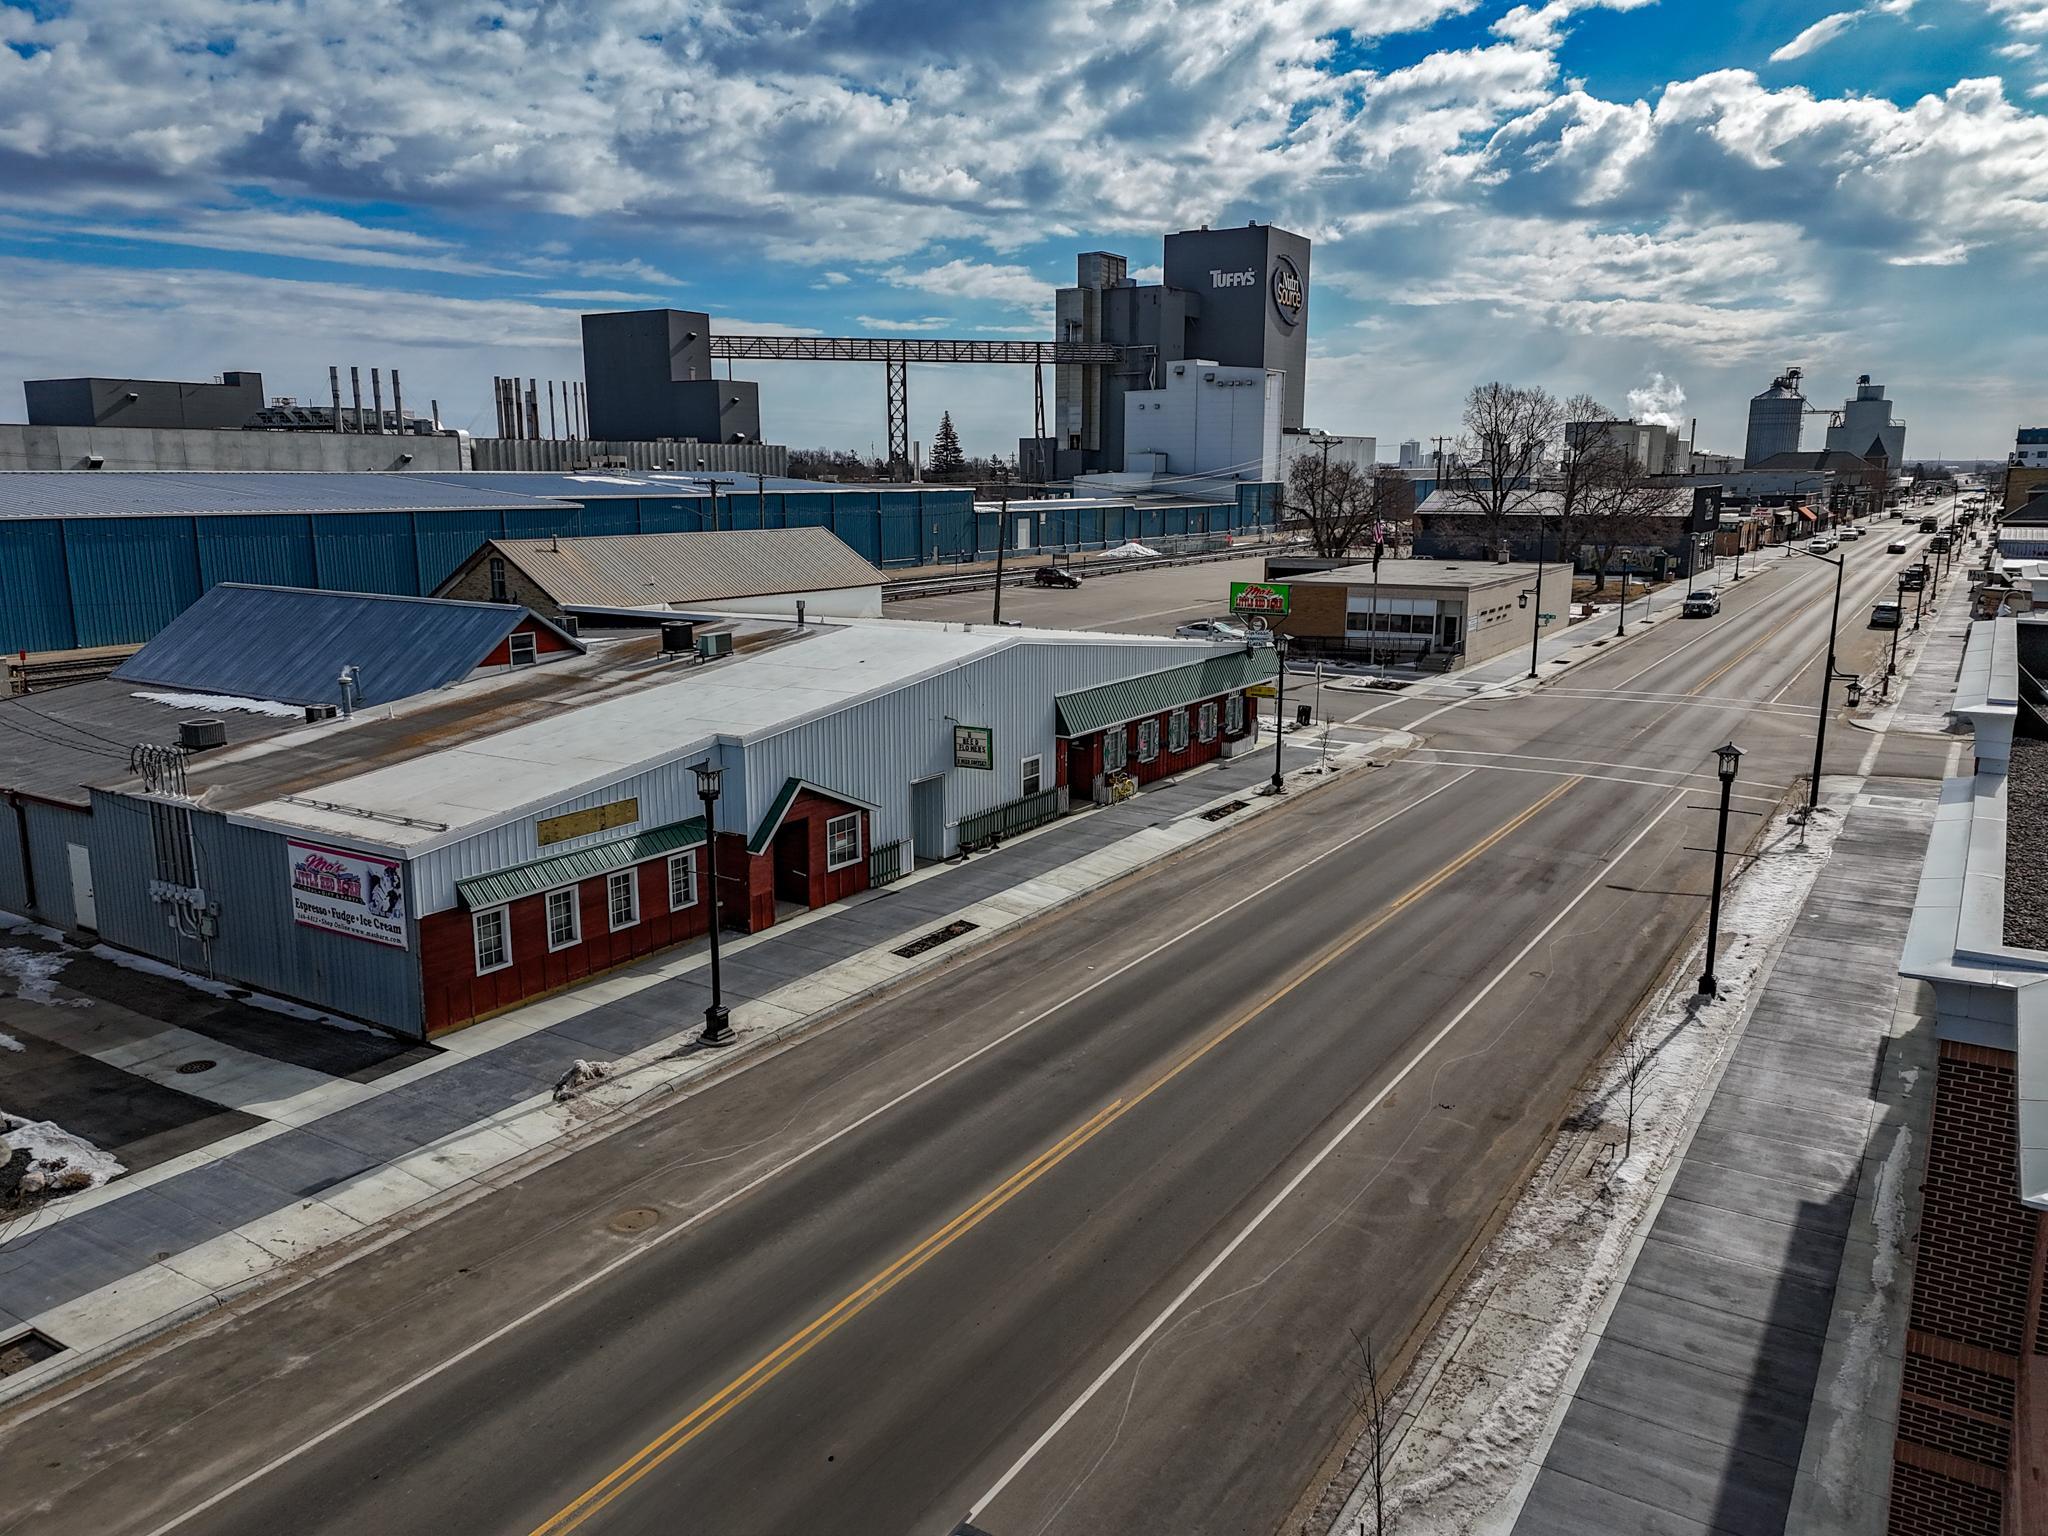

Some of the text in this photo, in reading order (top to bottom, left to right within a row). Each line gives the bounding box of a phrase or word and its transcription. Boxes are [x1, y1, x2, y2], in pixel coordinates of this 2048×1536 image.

[1282, 272, 1299, 291] Nutri
[1277, 283, 1301, 307] Source
[305, 854, 345, 874] Ma's
[295, 898, 402, 935] Espresso Fudge Ice Cream
[322, 918, 334, 928] Shop
[334, 921, 350, 931] Online
